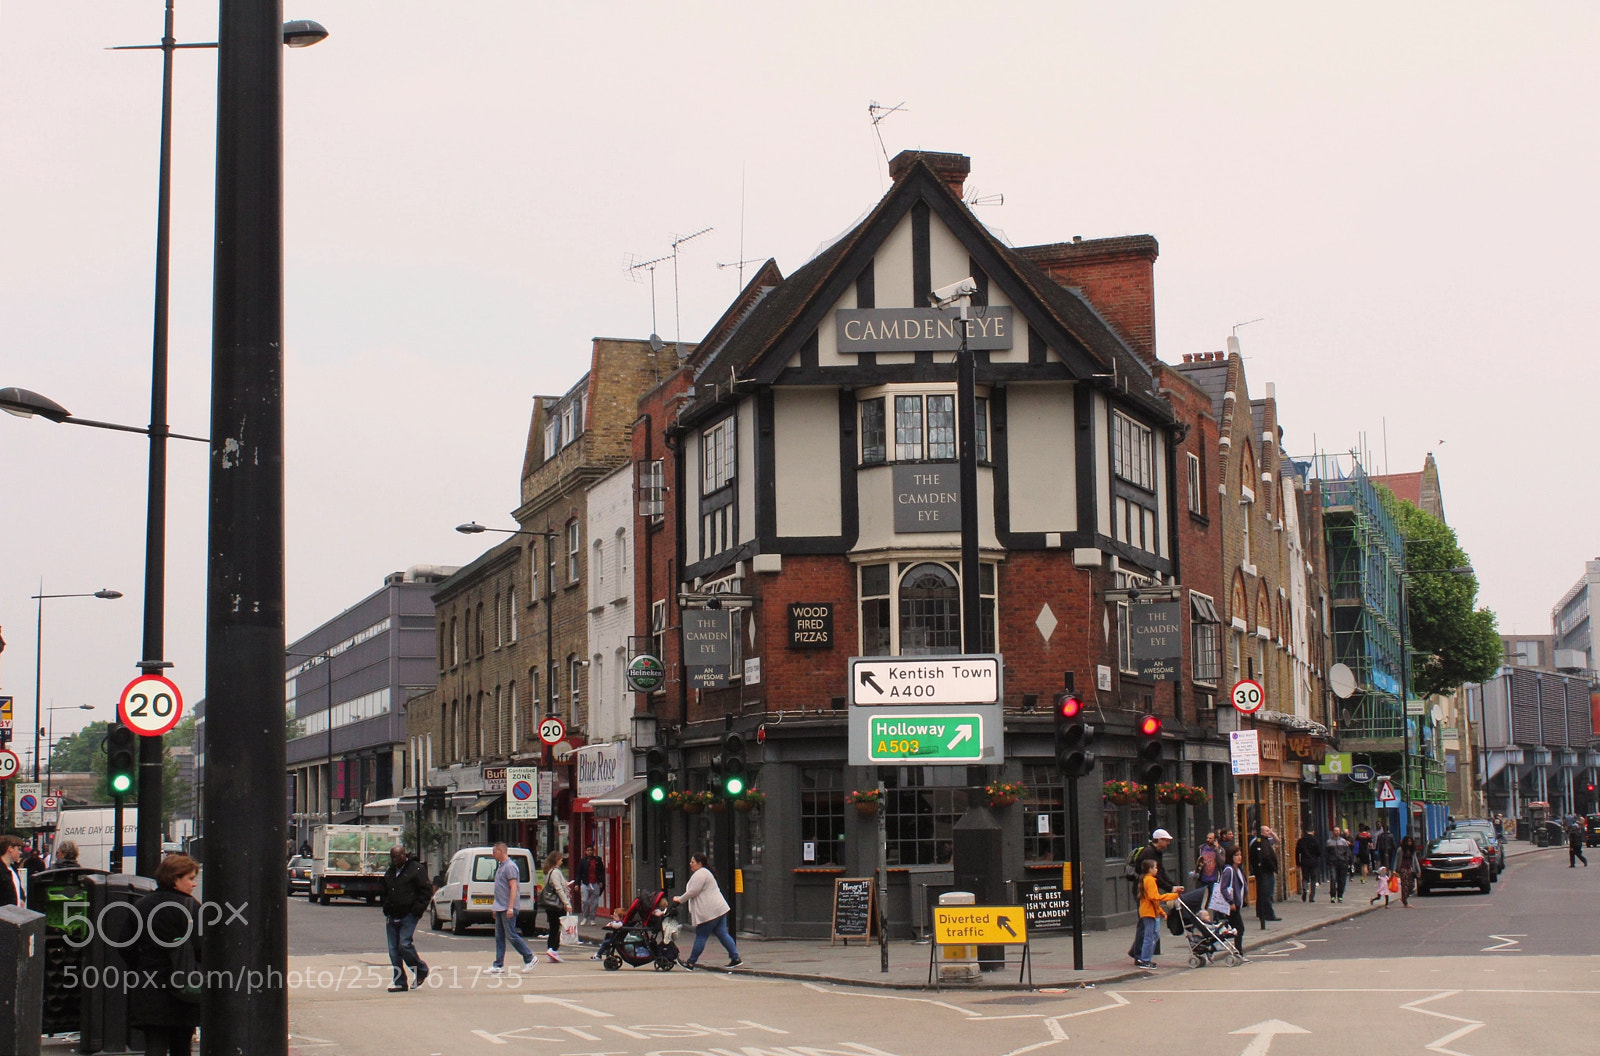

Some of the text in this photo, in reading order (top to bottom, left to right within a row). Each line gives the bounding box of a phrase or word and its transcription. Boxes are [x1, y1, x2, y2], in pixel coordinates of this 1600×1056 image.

[844, 317, 1005, 341] CAMDEN EYE
[913, 474, 940, 485] THE
[898, 493, 957, 505] CAMDEN
[918, 510, 939, 521] EYE
[792, 607, 828, 617] WOOD
[1148, 612, 1168, 620] THE
[697, 620, 717, 628] THE
[797, 619, 824, 630] FIRED
[1136, 625, 1179, 634] CAMDEN
[686, 632, 729, 641] CAMDEN
[794, 632, 828, 642] PIZZAS
[1150, 638, 1168, 646] EYE
[700, 644, 717, 653] EYE
[629, 669, 662, 677] Heineken
[889, 666, 992, 680] Kentish Town
[889, 684, 936, 698] A400
[1236, 689, 1260, 704] 30
[130, 693, 172, 717] 20
[542, 725, 561, 737] 20
[876, 722, 946, 738] Holloway
[877, 739, 920, 753] A503
[0, 758, 14, 771] 0
[579, 751, 617, 783] Blue Rose
[1354, 772, 1369, 780] HILL
[64, 825, 138, 835] SAME DAY DEERY
[1045, 891, 1062, 900] BEST
[1026, 902, 1039, 910] ISH
[1049, 900, 1070, 909] CHIPS
[939, 914, 990, 924] Diverted
[946, 927, 984, 937] traffic
